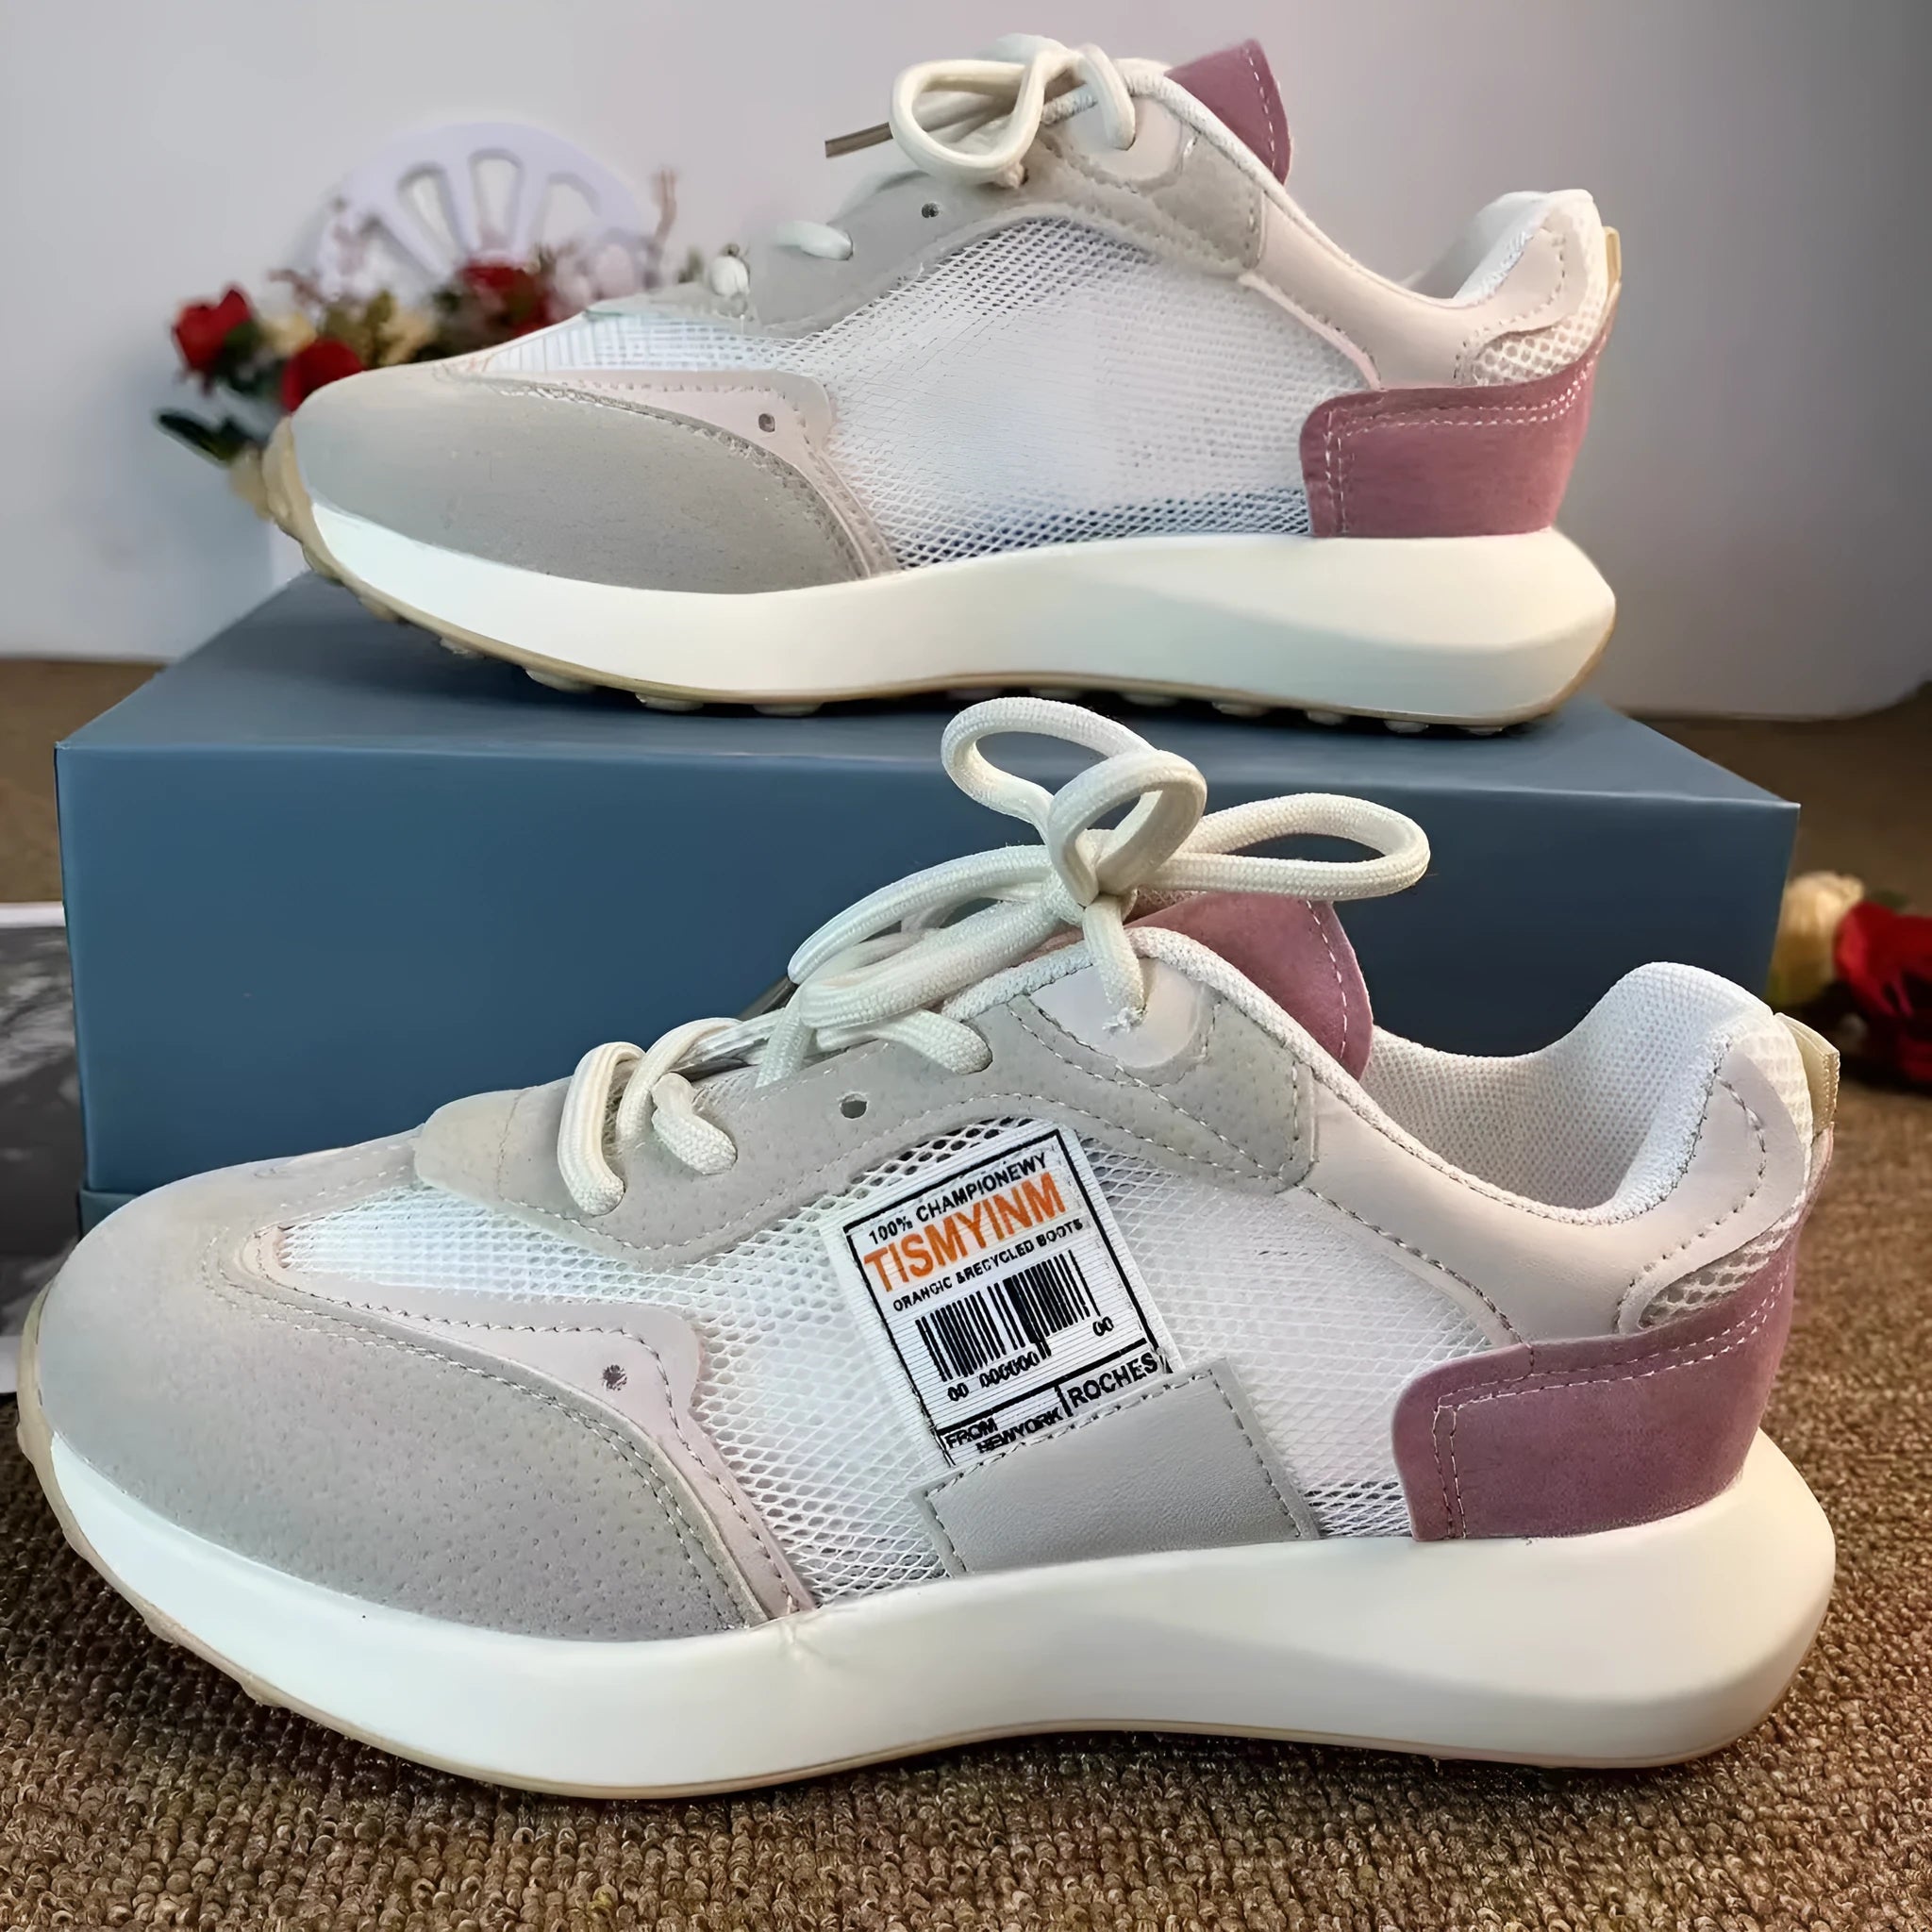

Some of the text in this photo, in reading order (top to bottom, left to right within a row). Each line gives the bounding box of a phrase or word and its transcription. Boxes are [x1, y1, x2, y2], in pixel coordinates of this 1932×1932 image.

[915, 1152, 1048, 1222] CHAMPIONEWY
[863, 1172, 1067, 1292] TISMYINM
[1037, 1218, 1084, 1248] BOOTS
[1068, 1351, 1158, 1407] ROCHES
